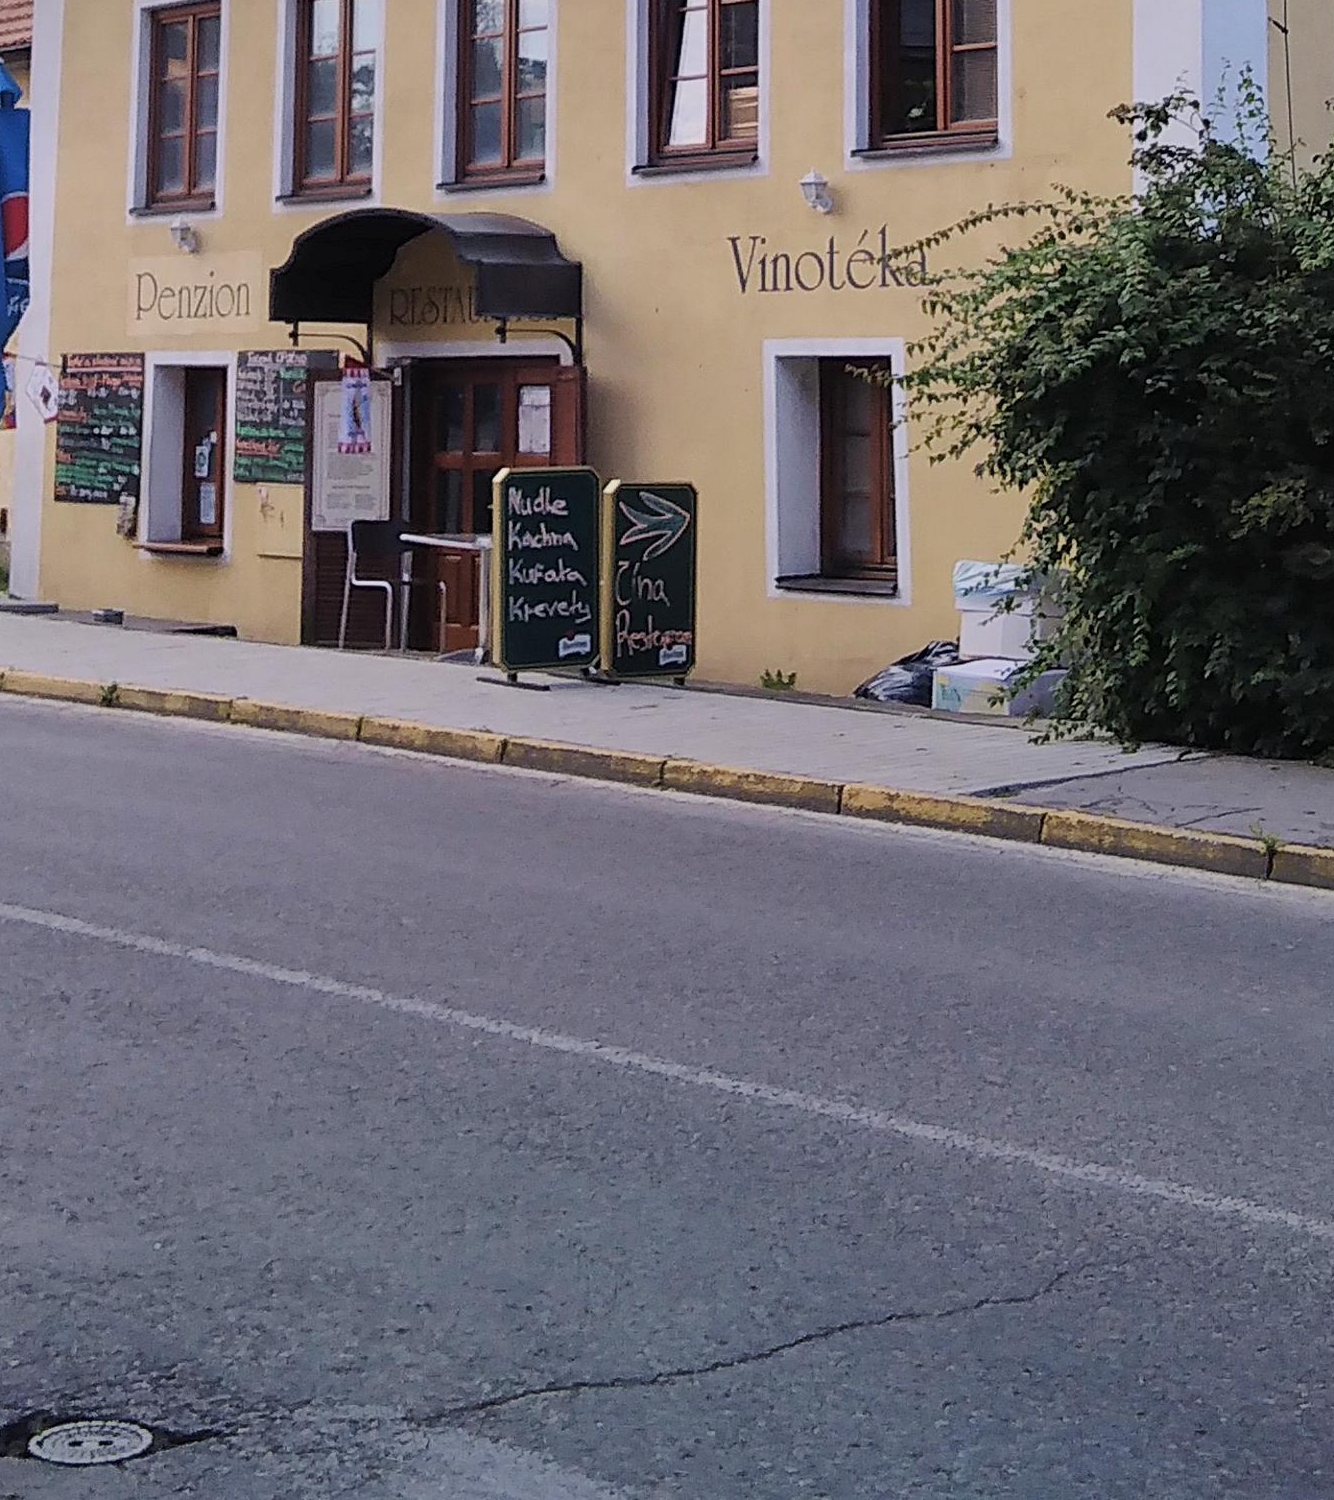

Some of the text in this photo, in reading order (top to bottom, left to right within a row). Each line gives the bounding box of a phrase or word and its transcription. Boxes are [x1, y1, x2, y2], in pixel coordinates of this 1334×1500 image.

[727, 223, 928, 294] Vinotéka
[135, 270, 251, 321] Penzion
[508, 486, 569, 517] Nudle
[508, 520, 579, 551] Kachna
[509, 590, 591, 623] Krevety
